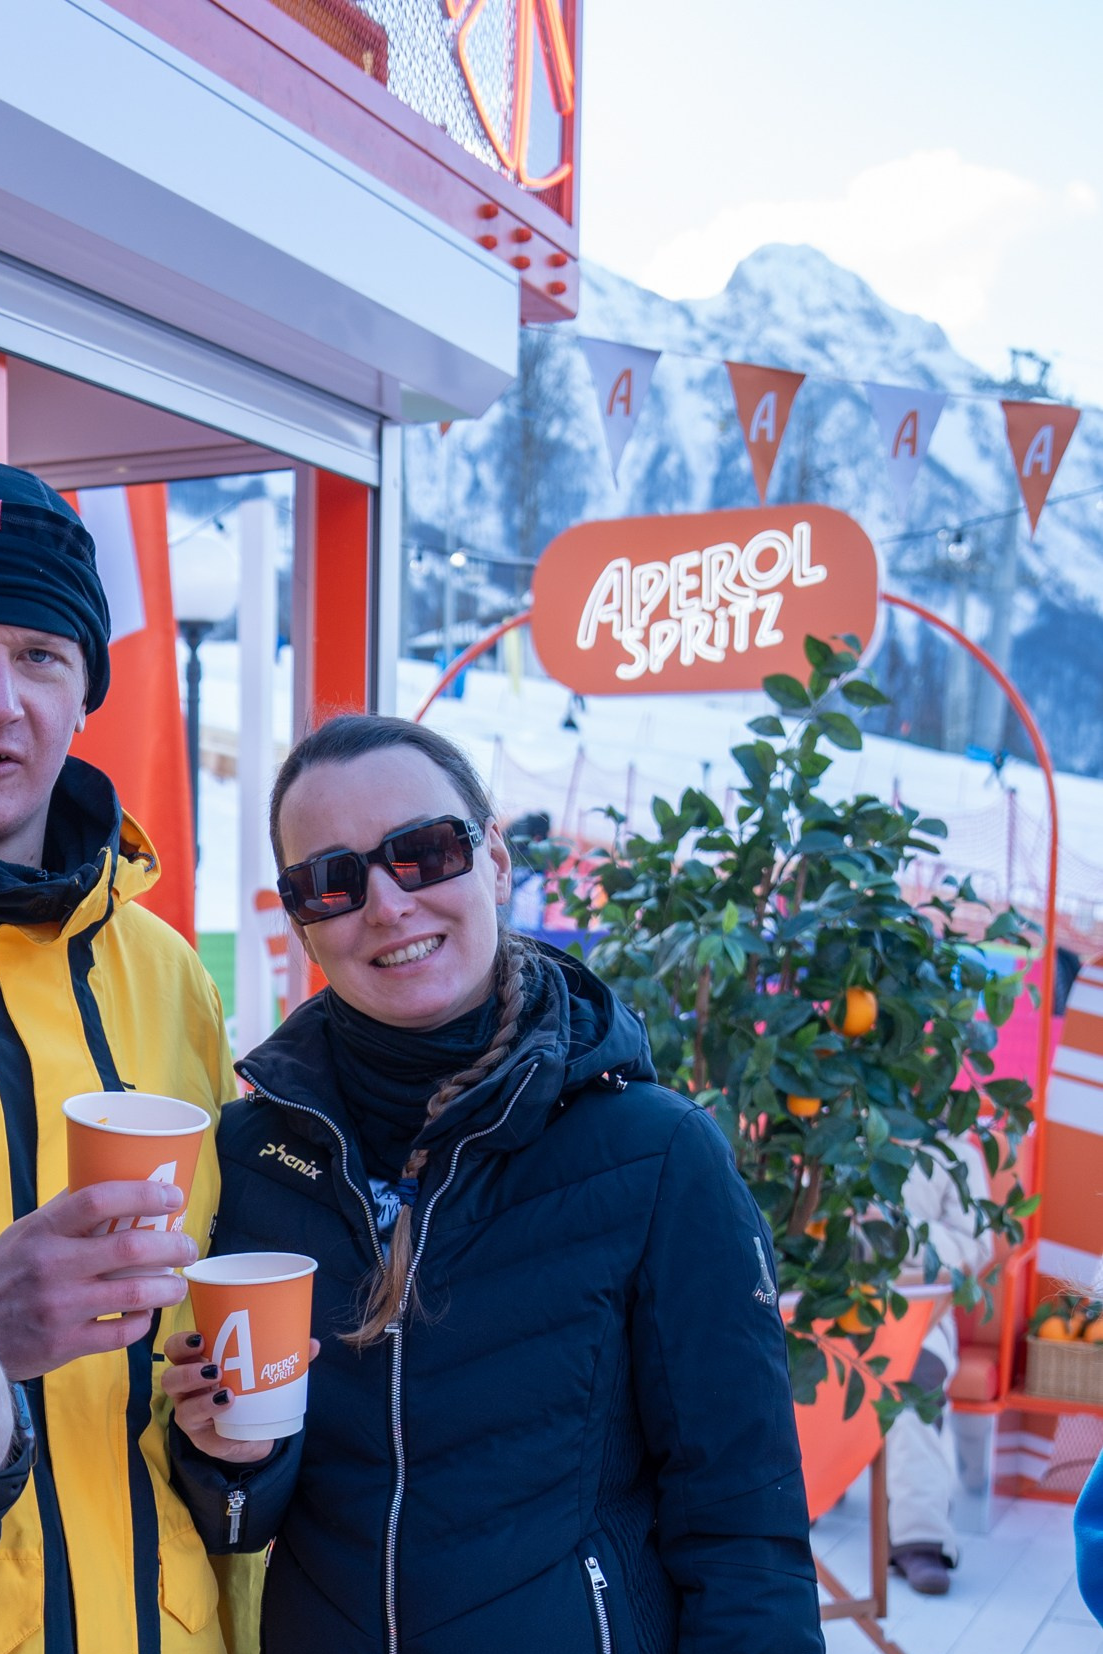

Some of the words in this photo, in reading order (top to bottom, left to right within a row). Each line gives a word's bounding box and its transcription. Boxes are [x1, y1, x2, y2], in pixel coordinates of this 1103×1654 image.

[607, 368, 632, 416] A
[749, 391, 778, 443] A
[891, 409, 919, 459] A
[1022, 424, 1054, 478] A
[576, 521, 828, 650] APEROL
[211, 1309, 256, 1391] A
[260, 1352, 300, 1380] APEROL
